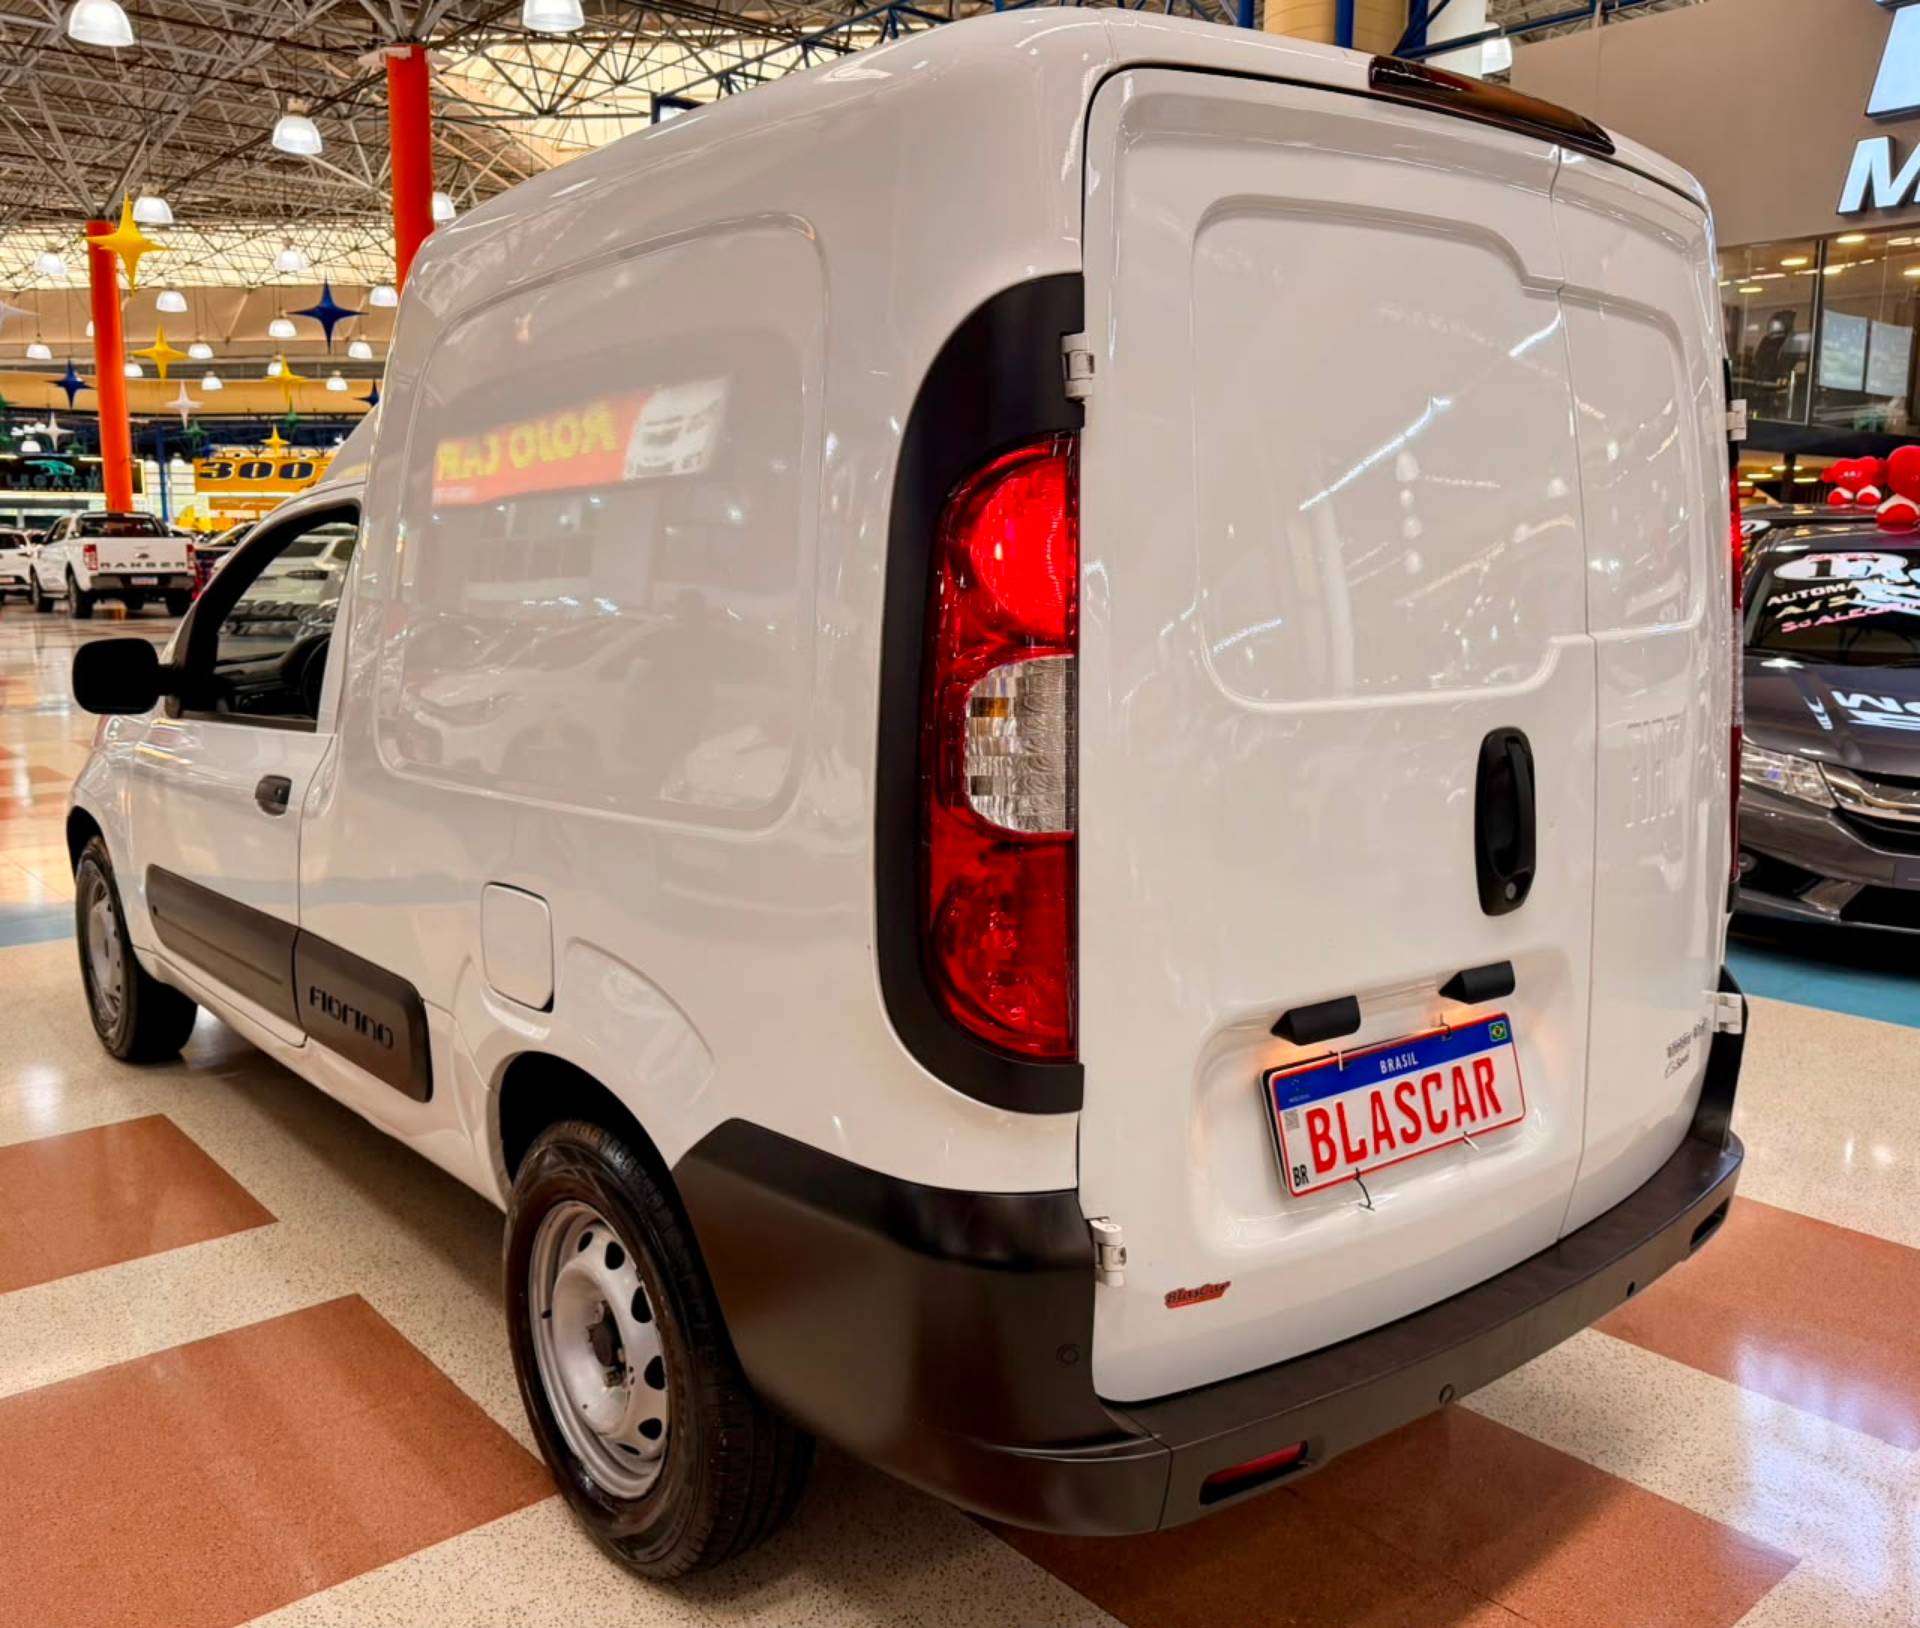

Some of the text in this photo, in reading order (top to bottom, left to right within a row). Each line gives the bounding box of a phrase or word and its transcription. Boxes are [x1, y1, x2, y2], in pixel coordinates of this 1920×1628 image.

[1379, 1051, 1419, 1075] BRASIL
[1305, 1056, 1503, 1175] BLASCAR
[1292, 1164, 1310, 1188] BR
